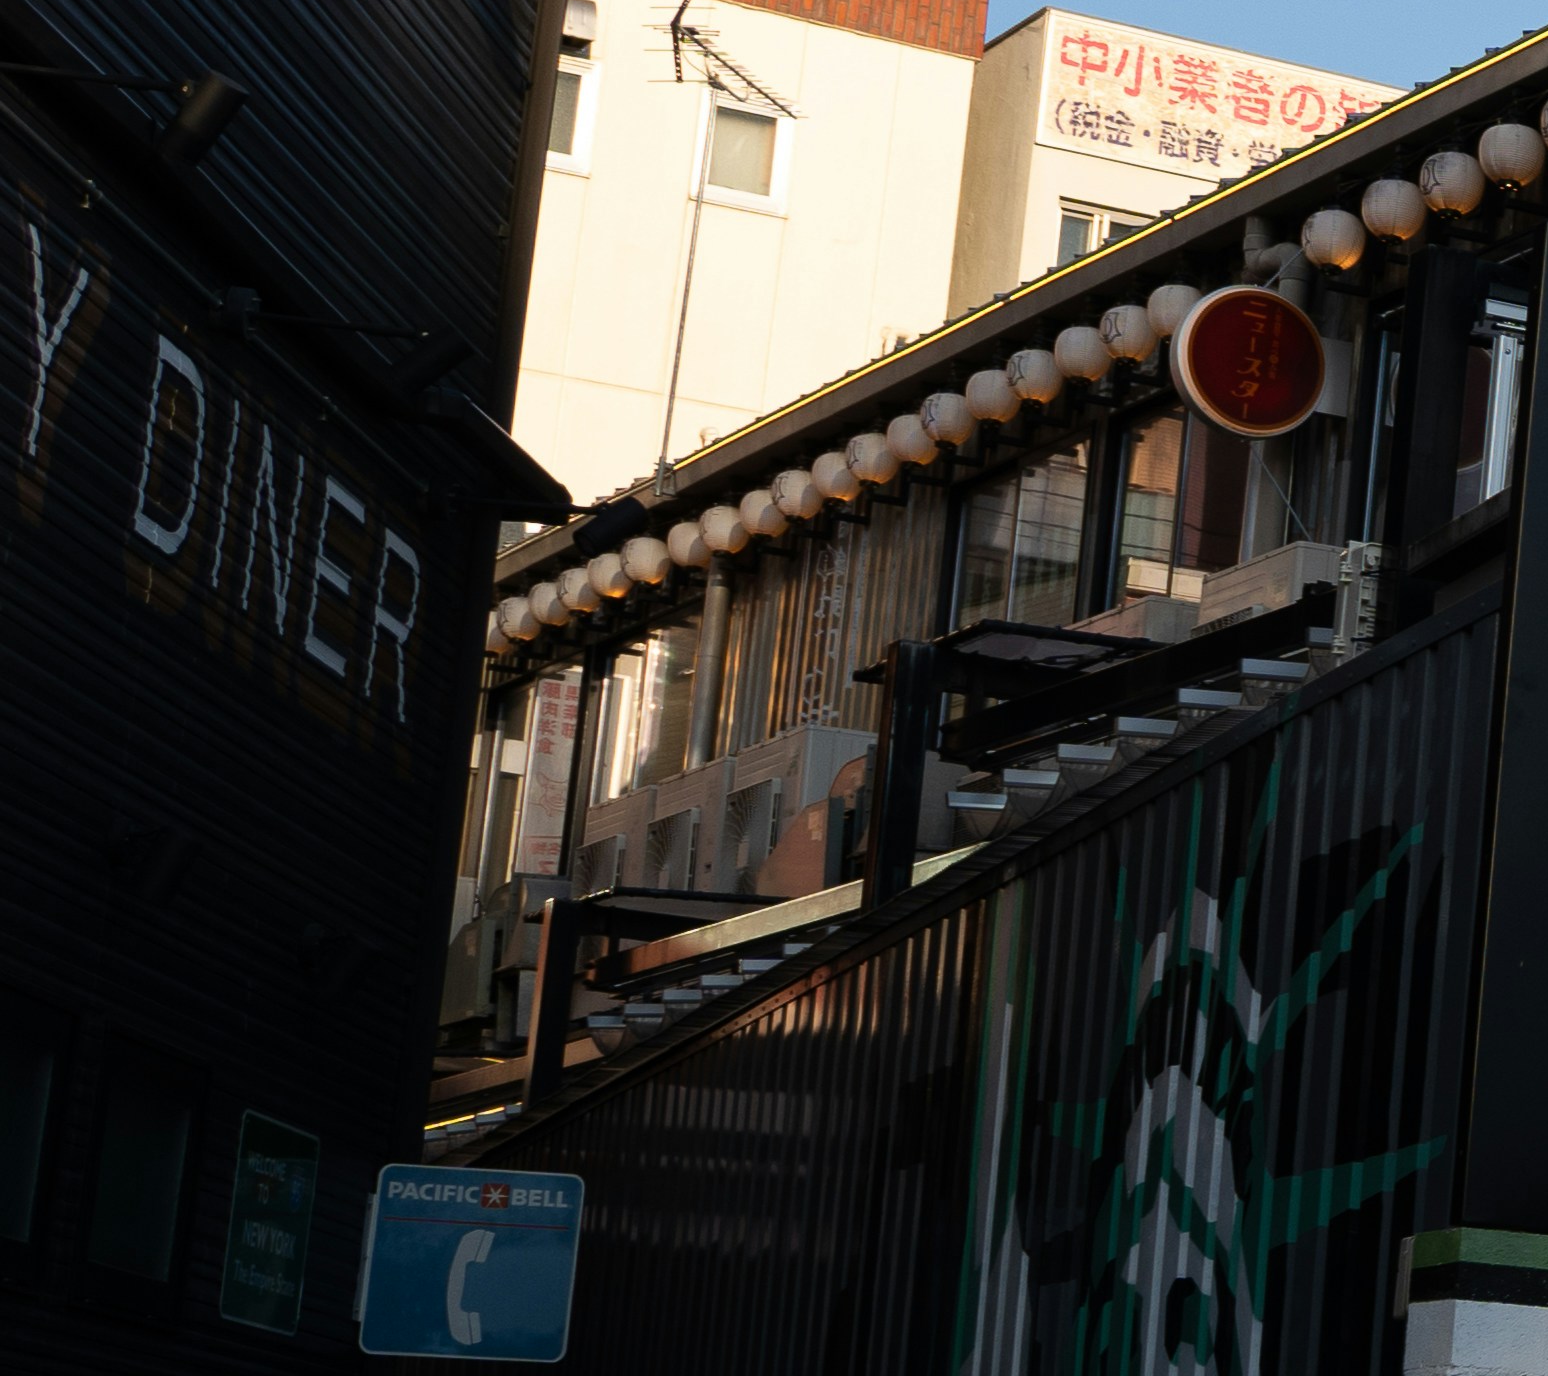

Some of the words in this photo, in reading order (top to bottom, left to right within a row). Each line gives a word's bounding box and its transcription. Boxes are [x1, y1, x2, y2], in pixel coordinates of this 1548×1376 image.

[1230, 300, 1268, 419] ニュースター
[134, 334, 422, 723] DINER
[248, 1151, 287, 1182] WELCOME
[258, 1184, 269, 1205] TO
[387, 1179, 480, 1207] PACIFIC
[510, 1185, 569, 1209] BELL
[243, 1218, 268, 1250] NEW
[270, 1225, 296, 1260] YORK
